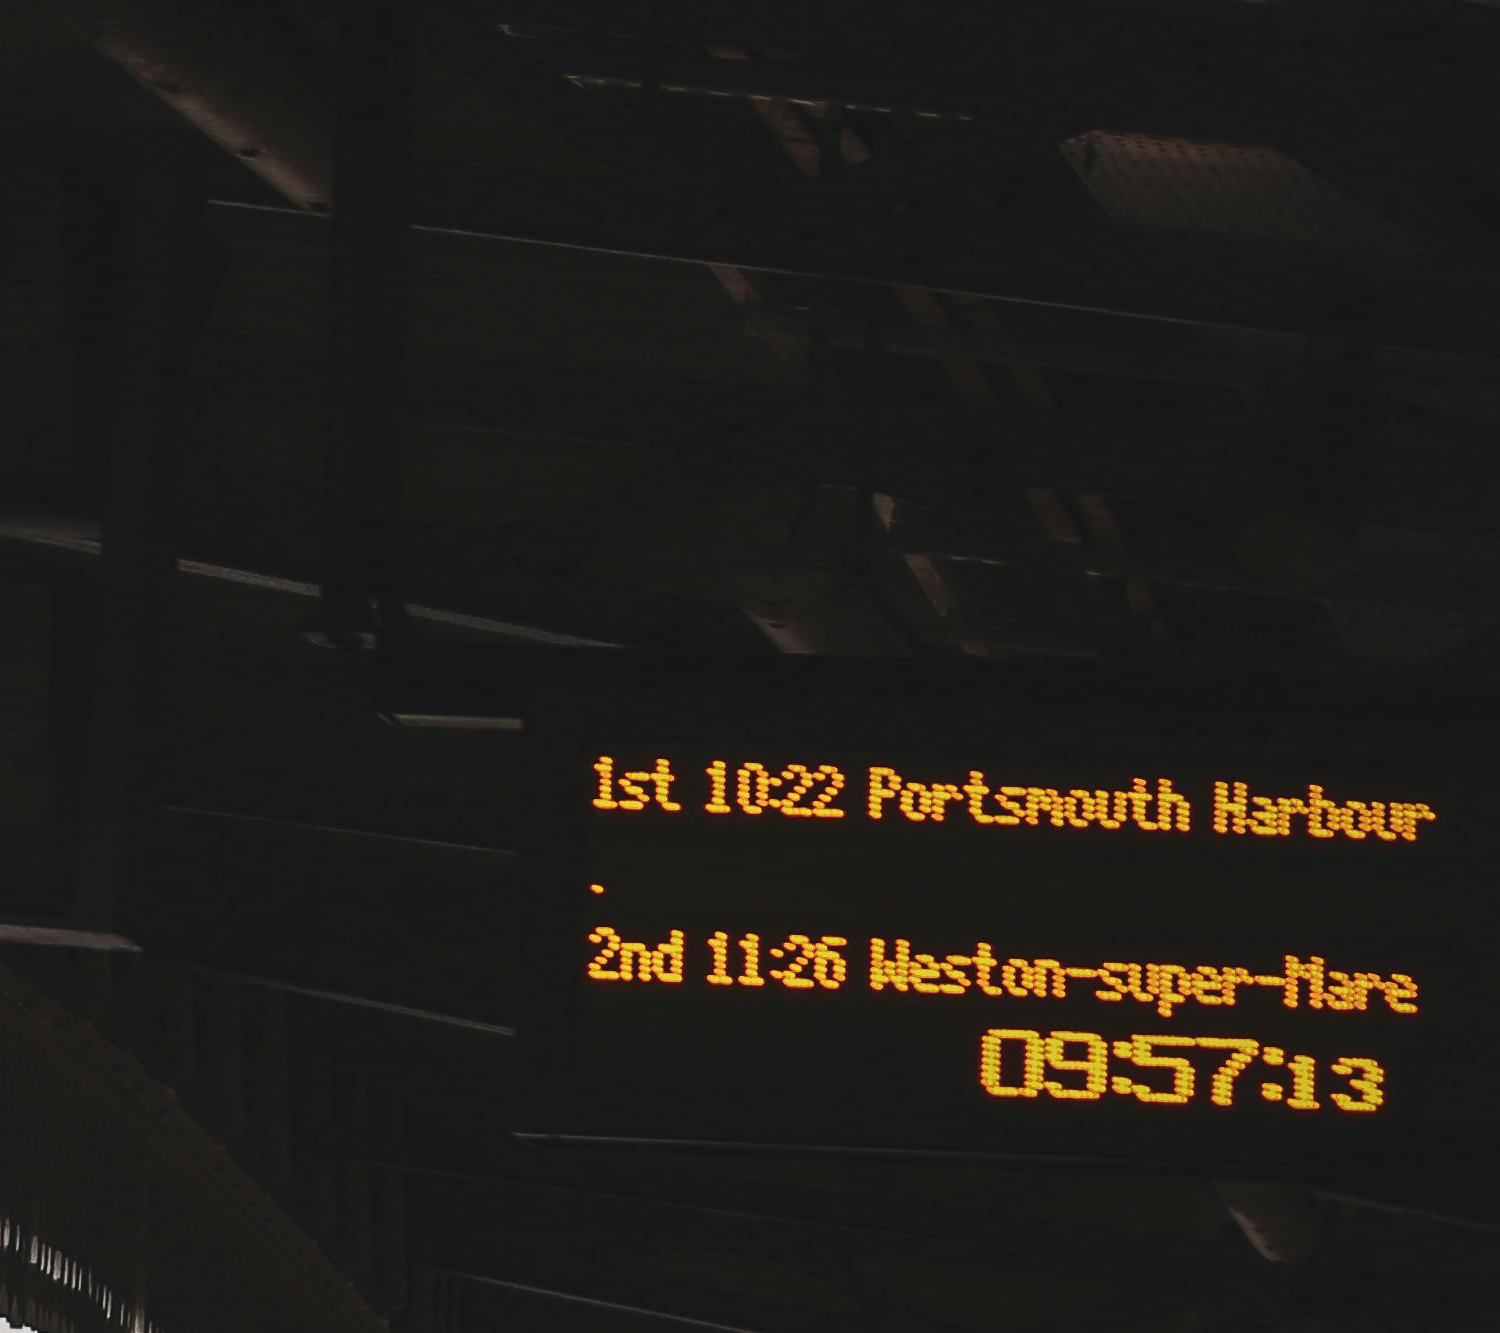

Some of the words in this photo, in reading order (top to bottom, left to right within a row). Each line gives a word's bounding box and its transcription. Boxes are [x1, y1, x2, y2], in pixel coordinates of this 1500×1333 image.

[592, 756, 681, 811] 1st
[705, 761, 845, 818] 10:22
[868, 767, 1191, 832] Portsmouth
[1213, 781, 1436, 841] Harbour
[588, 927, 684, 983] 2nd
[706, 931, 847, 989] 11:26
[870, 938, 1418, 1018] Weston-super-Mare
[980, 1029, 1385, 1112] 09:57:13
